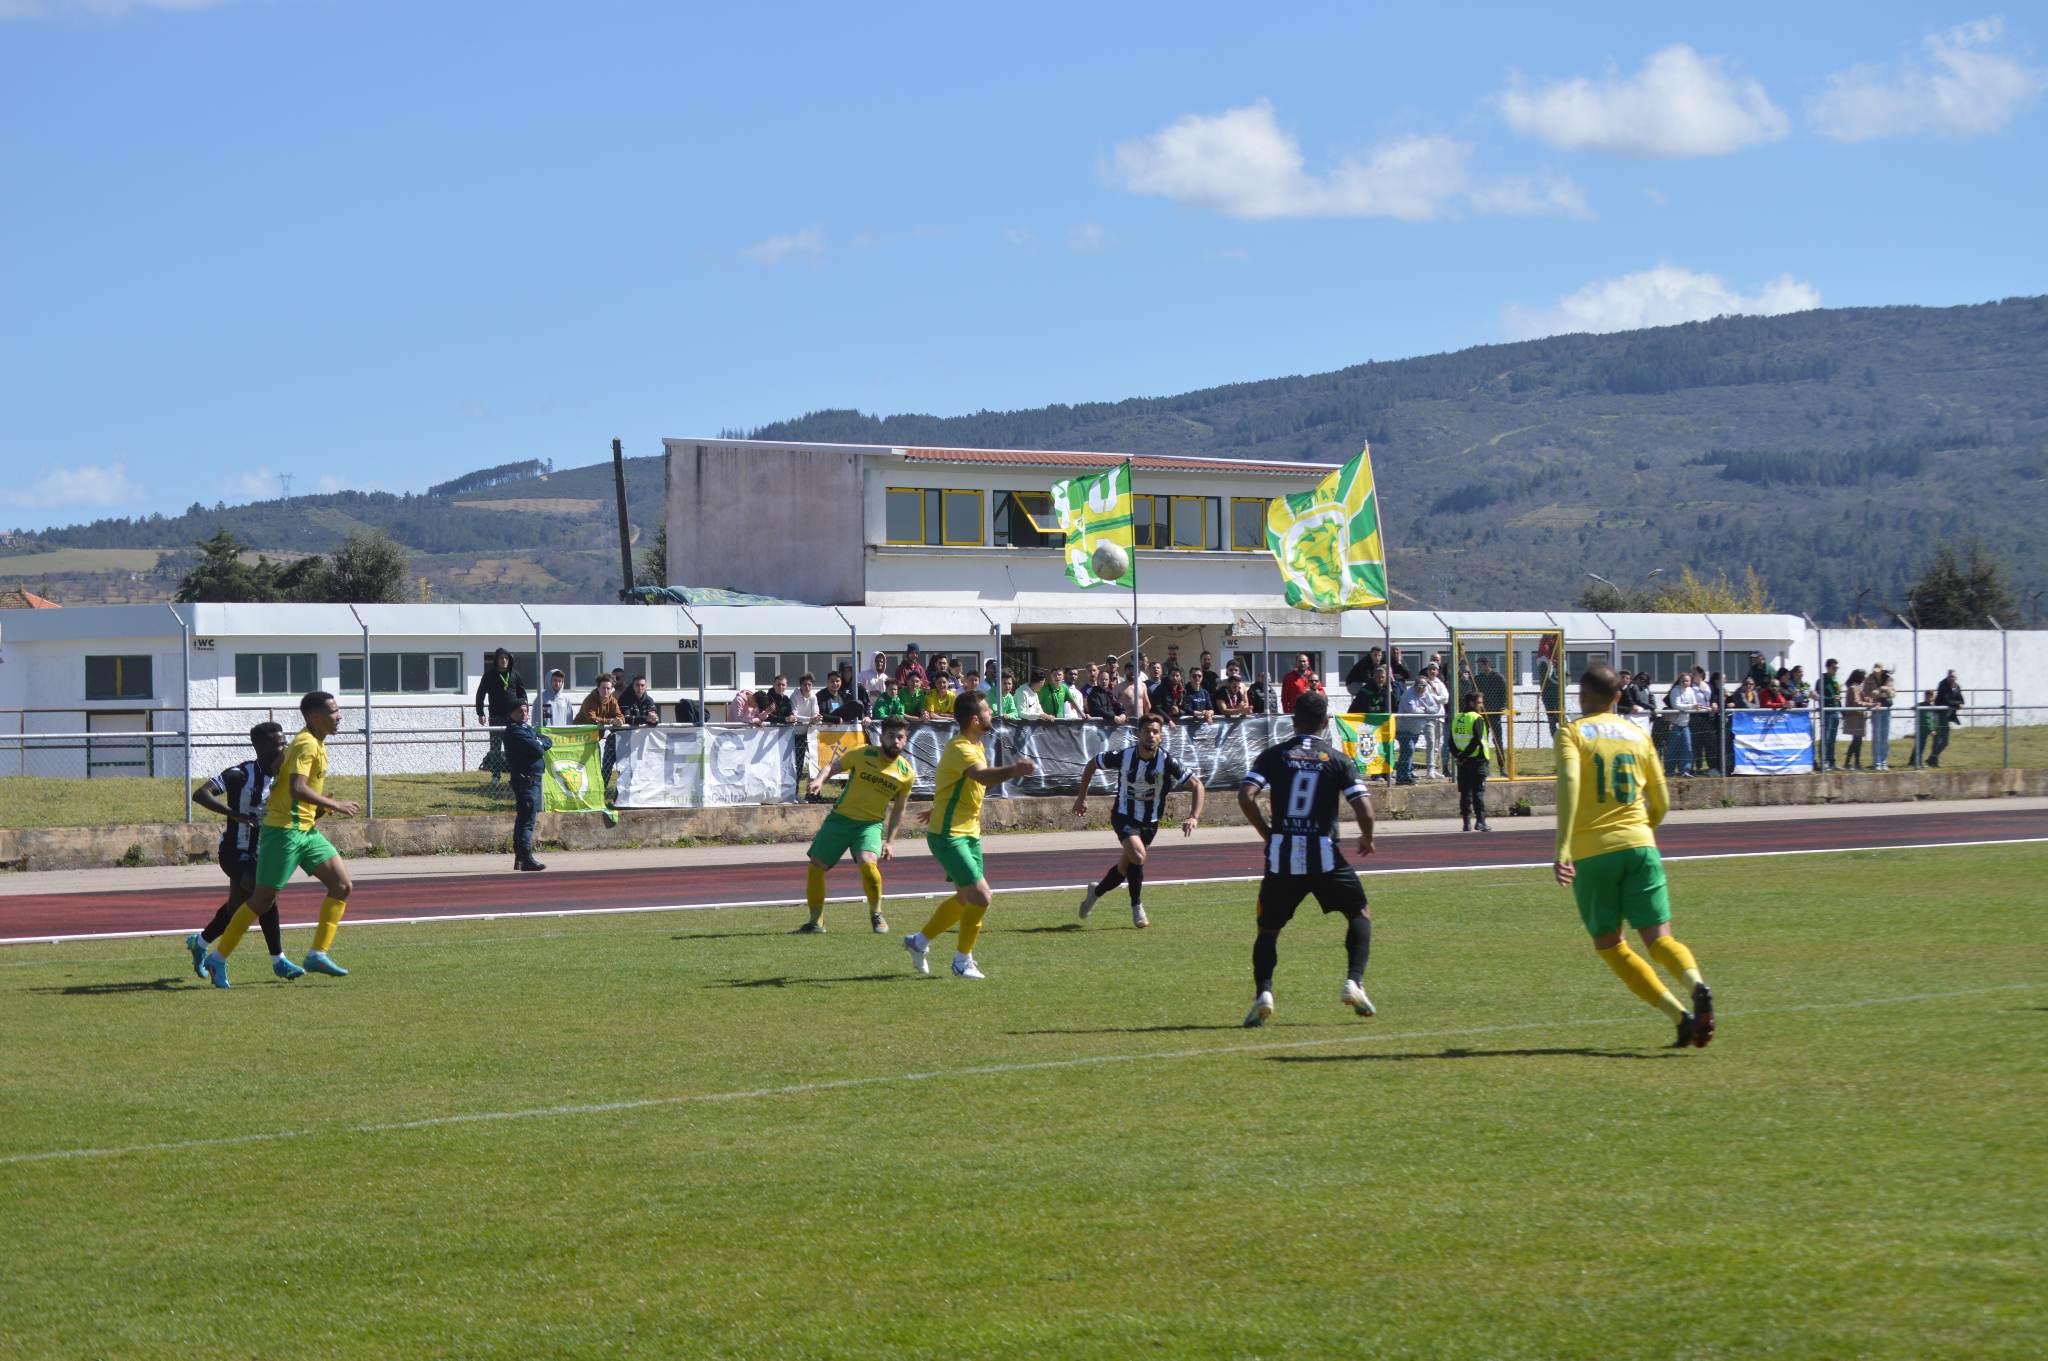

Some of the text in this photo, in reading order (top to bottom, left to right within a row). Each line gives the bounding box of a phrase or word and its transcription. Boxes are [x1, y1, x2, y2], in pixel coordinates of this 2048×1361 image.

[198, 638, 214, 647] WC
[678, 639, 698, 649] BAR
[1592, 753, 1636, 804] 16
[1287, 770, 1320, 818] 8
